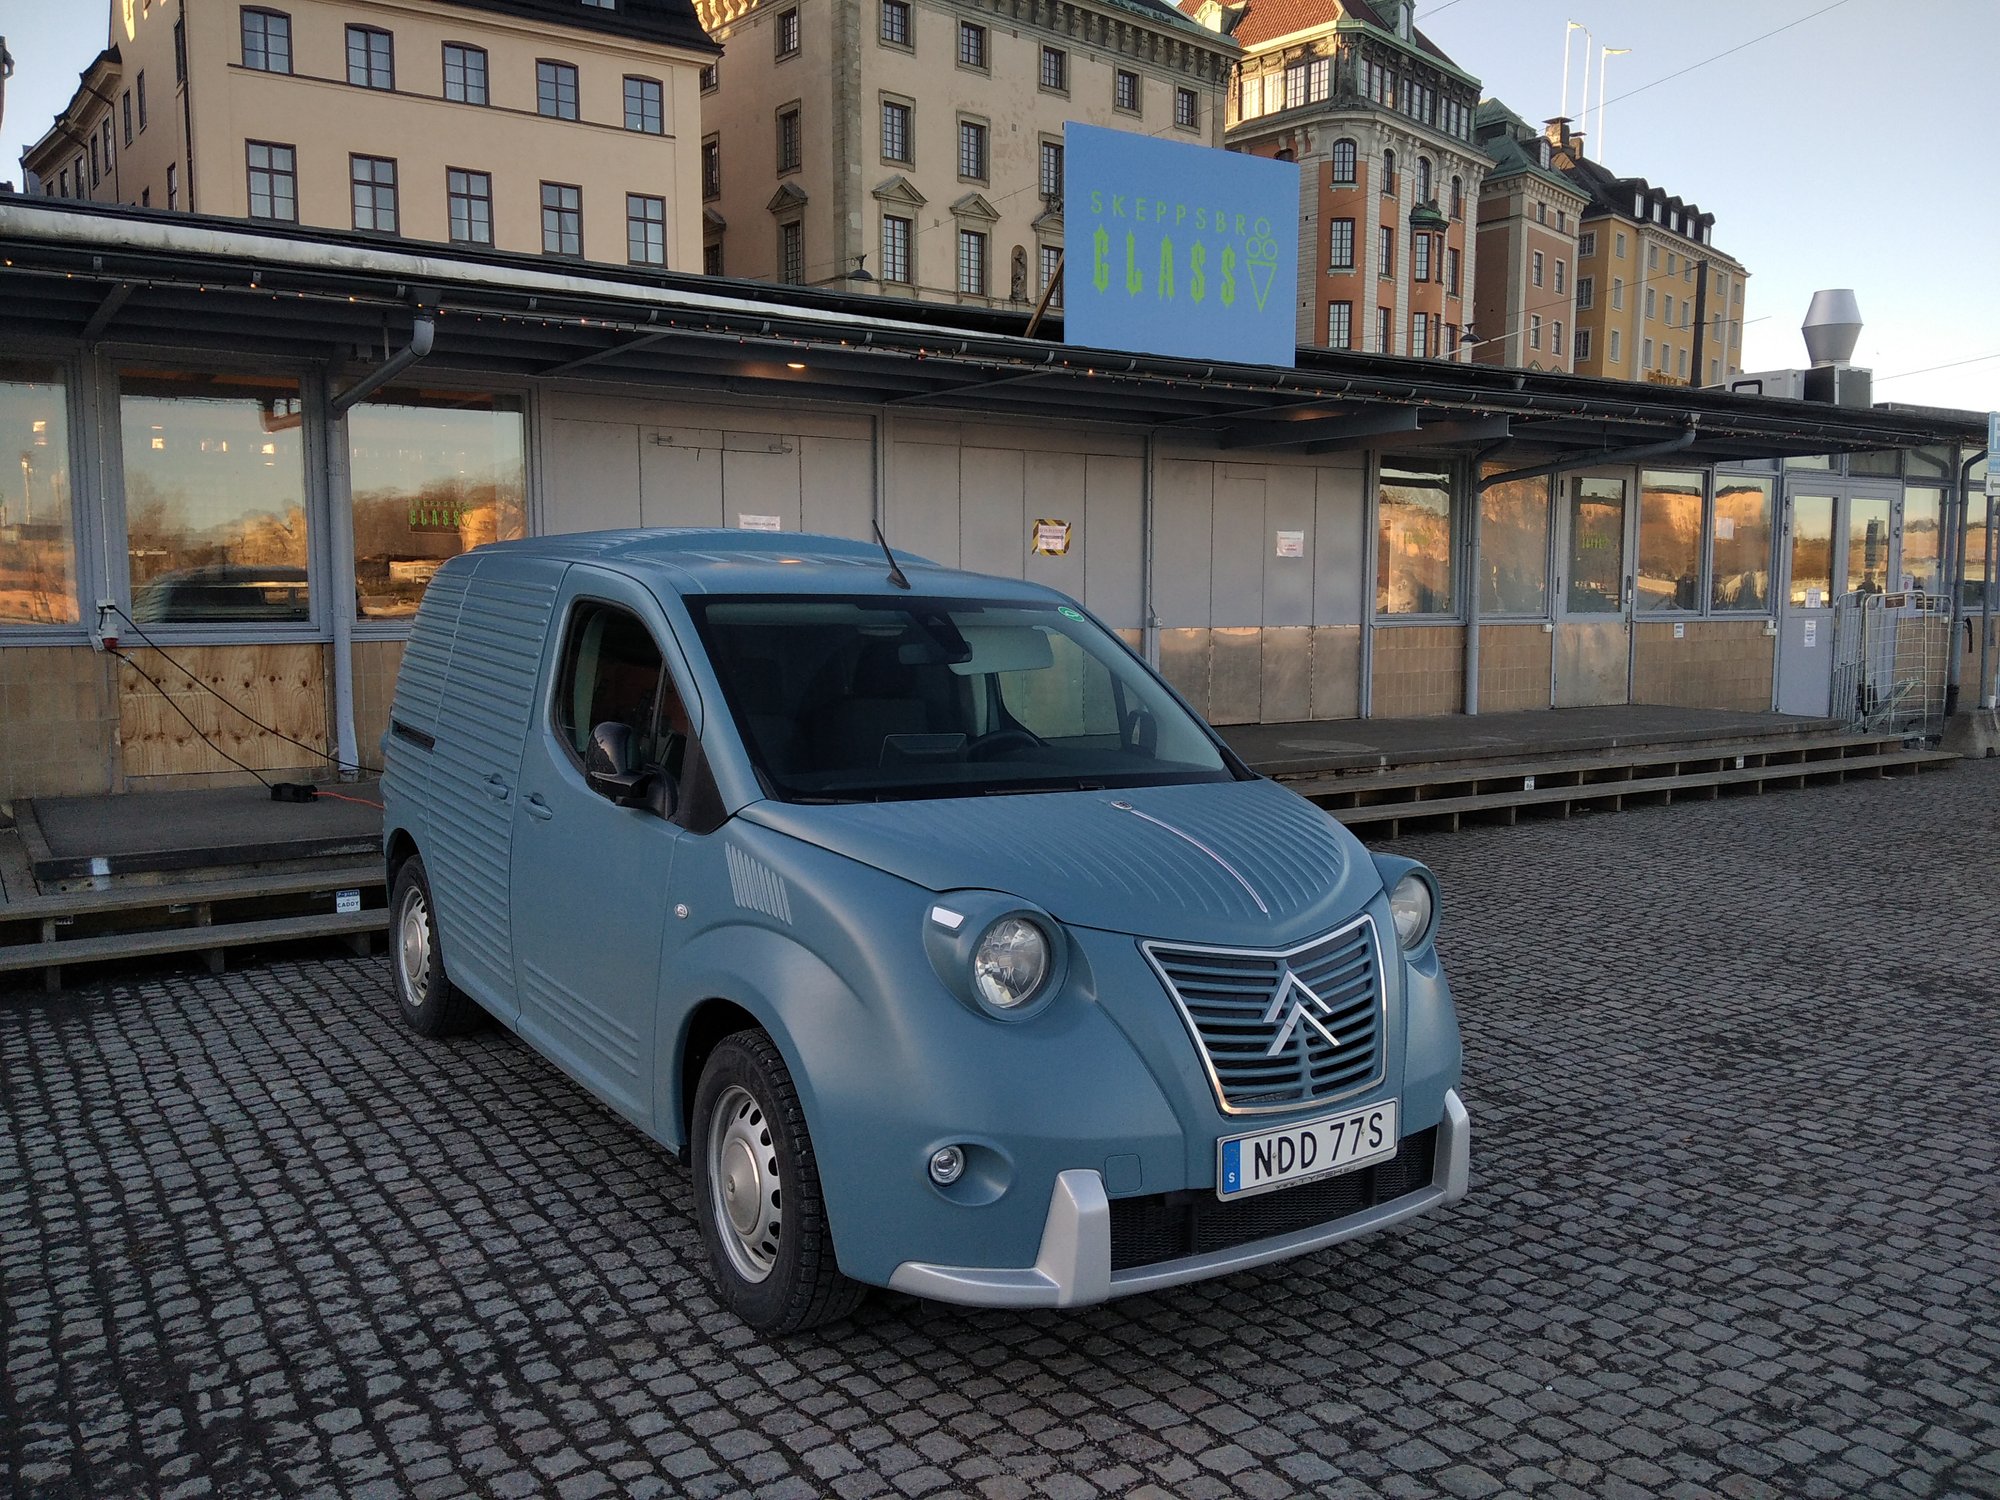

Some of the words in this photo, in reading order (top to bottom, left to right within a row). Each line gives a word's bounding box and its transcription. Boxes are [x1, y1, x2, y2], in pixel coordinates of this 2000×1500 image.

[1093, 223, 1237, 309] GLASS
[1228, 1172, 1236, 1183] S
[1254, 1131, 1318, 1180] NDD
[1329, 1112, 1384, 1161] 77S
